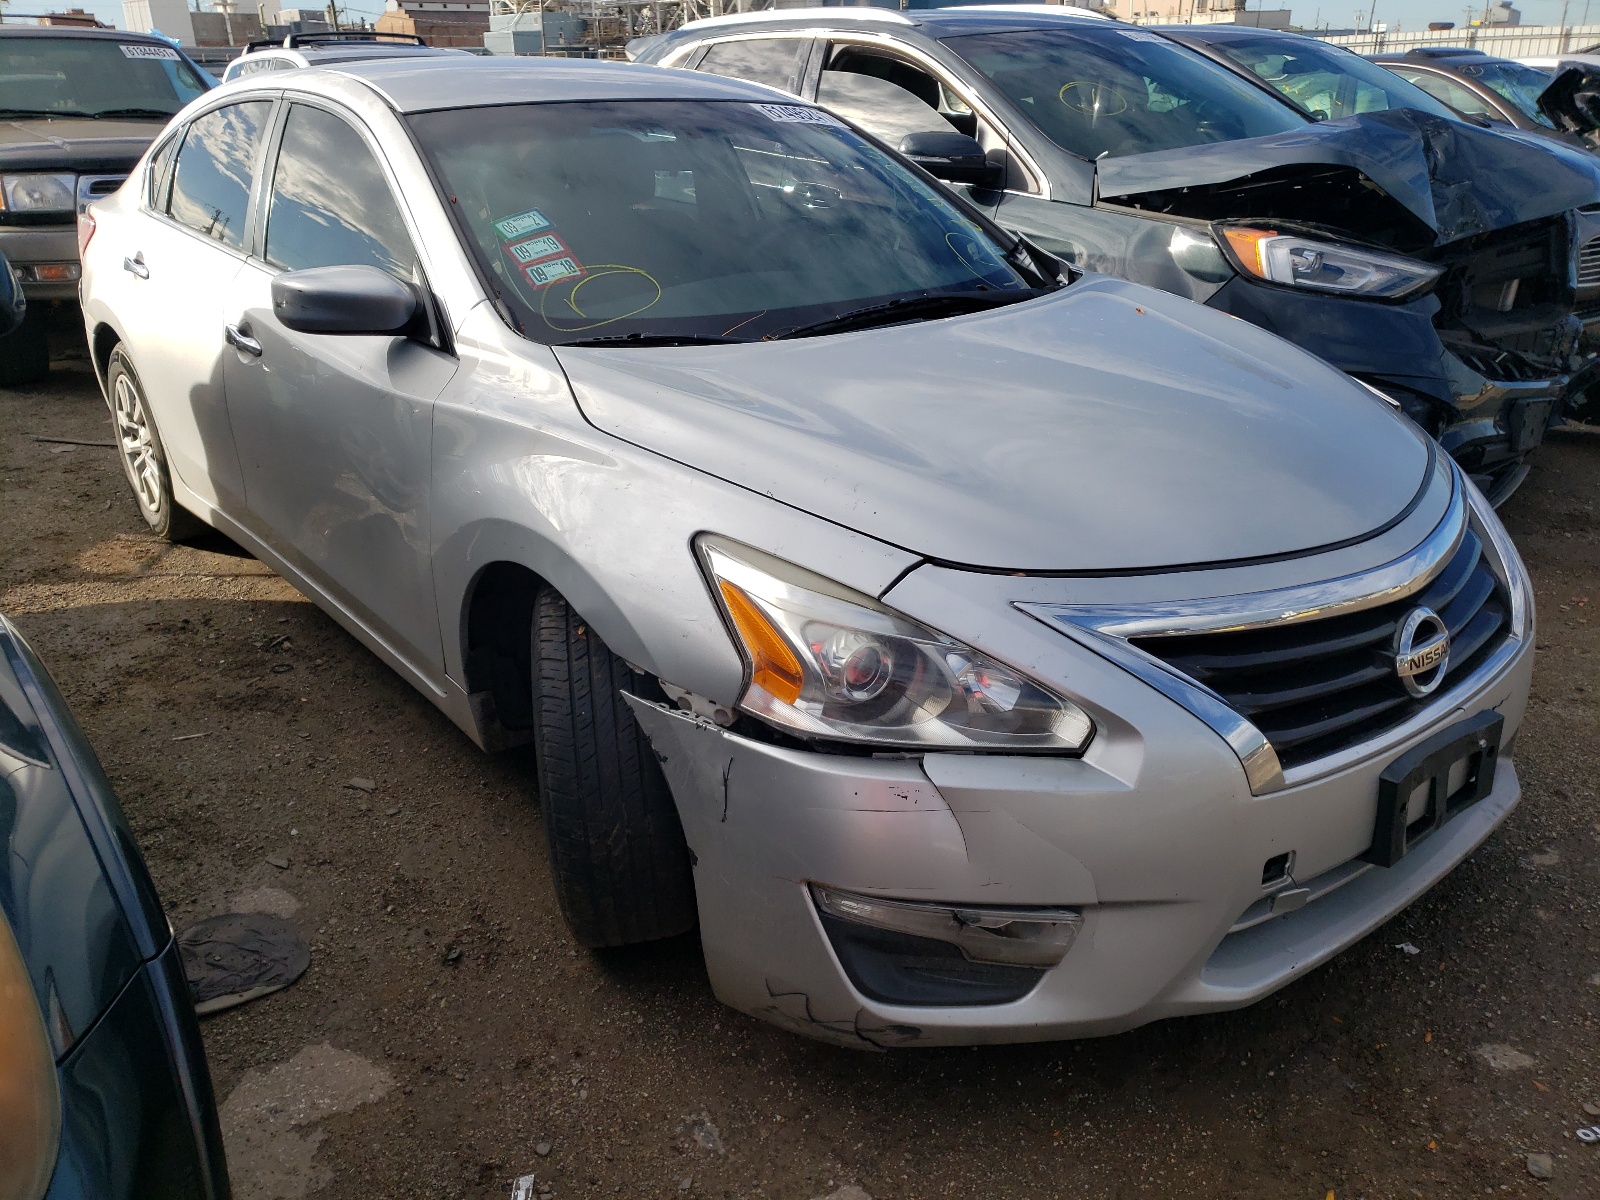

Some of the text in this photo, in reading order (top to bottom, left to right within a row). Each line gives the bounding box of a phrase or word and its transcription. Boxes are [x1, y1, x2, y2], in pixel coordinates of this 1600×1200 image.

[514, 245, 532, 260] 09
[543, 237, 559, 251] 19
[530, 267, 549, 283] 09
[560, 260, 577, 274] 18
